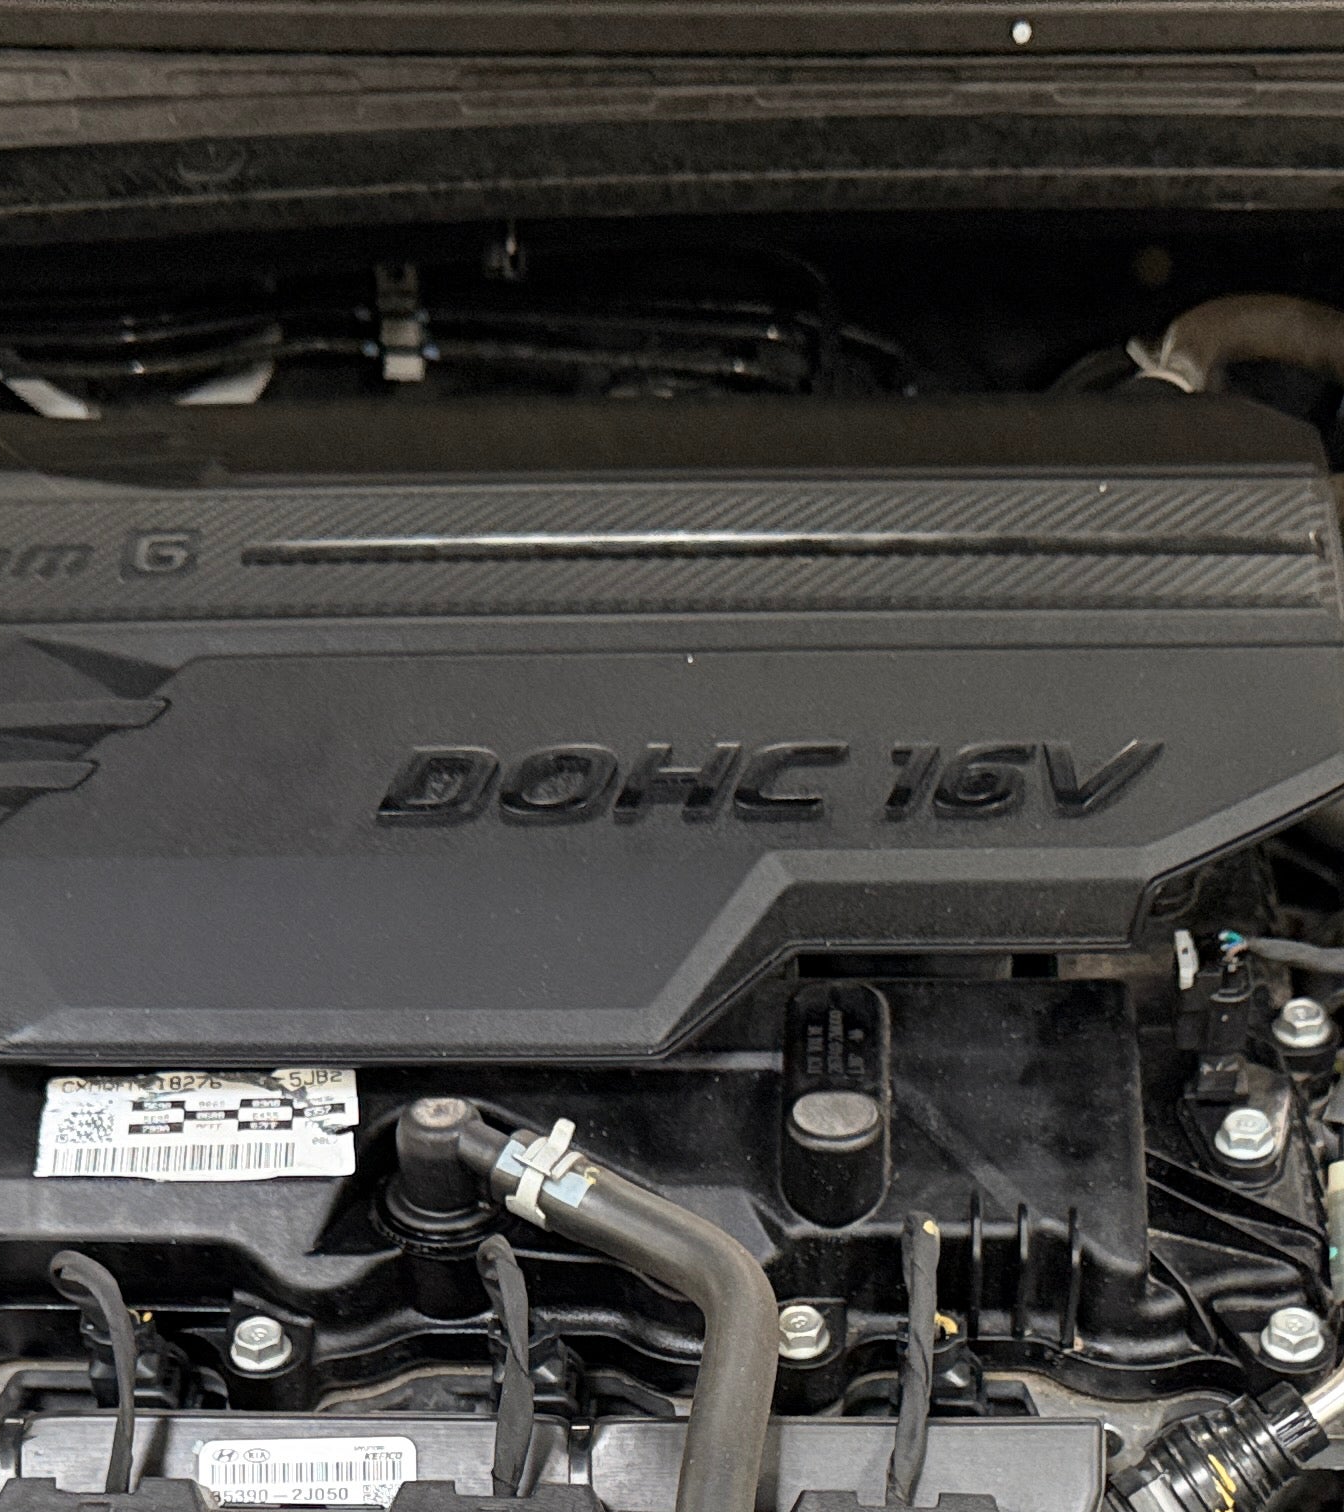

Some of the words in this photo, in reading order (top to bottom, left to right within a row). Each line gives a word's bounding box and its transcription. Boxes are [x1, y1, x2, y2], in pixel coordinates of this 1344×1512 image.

[376, 741, 851, 827] DOHC
[885, 740, 1164, 824] 16V
[289, 1070, 343, 1088] 5JB2
